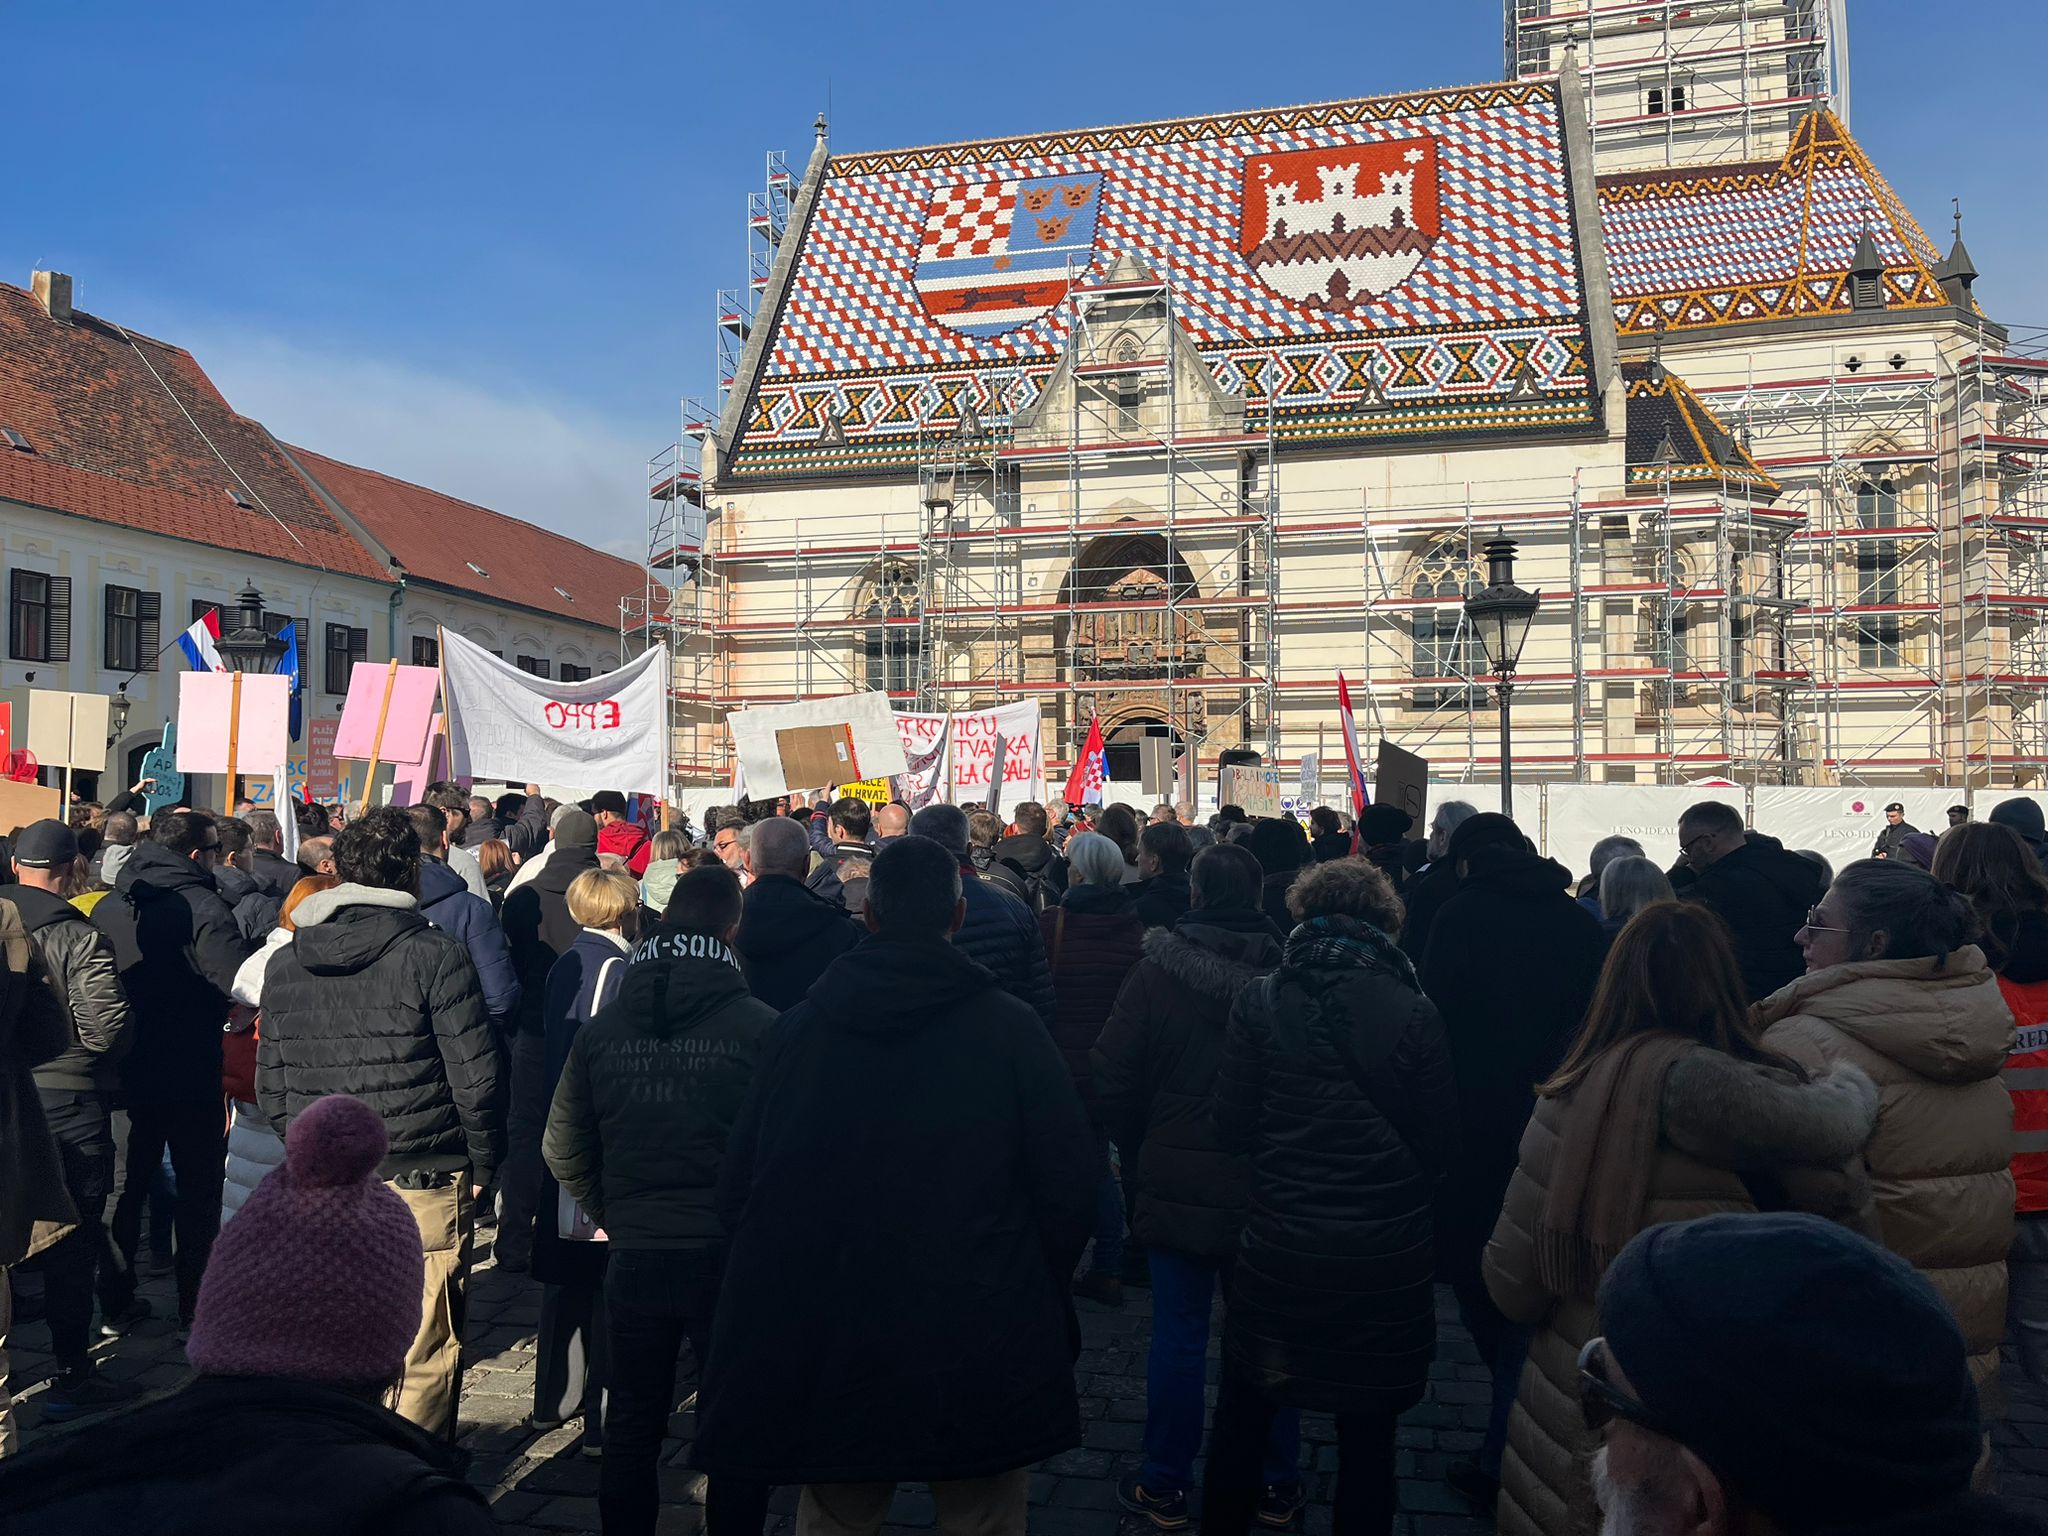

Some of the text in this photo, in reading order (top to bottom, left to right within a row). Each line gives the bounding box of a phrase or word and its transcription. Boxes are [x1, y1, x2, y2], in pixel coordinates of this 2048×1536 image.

[312, 725, 334, 735] PLAŽE
[153, 758, 172, 772] AP
[313, 758, 331, 766] SAMO
[842, 788, 852, 797] NI
[1824, 829, 1878, 839] LENO-IDE
